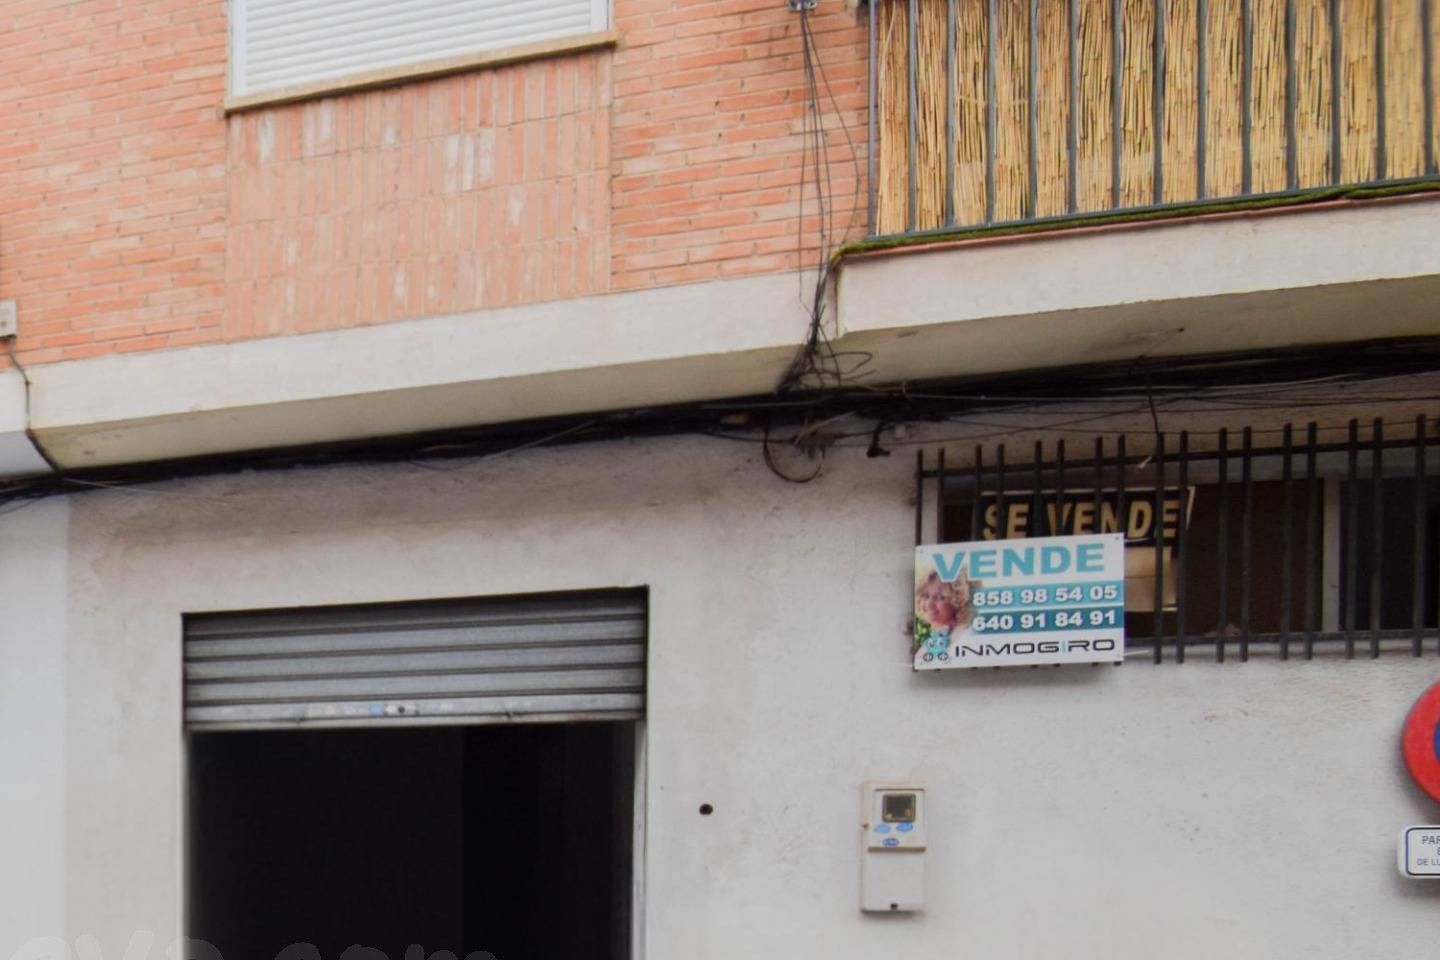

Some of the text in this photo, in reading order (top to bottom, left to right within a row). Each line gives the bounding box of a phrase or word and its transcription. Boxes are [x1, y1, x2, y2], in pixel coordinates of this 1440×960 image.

[982, 499, 1179, 539] SE VENDE
[932, 543, 1105, 581] VENDE
[972, 585, 1118, 606] 858 98 54 05
[972, 610, 1116, 631] 640 91 84 91
[955, 639, 1115, 657] INMOGIRO
